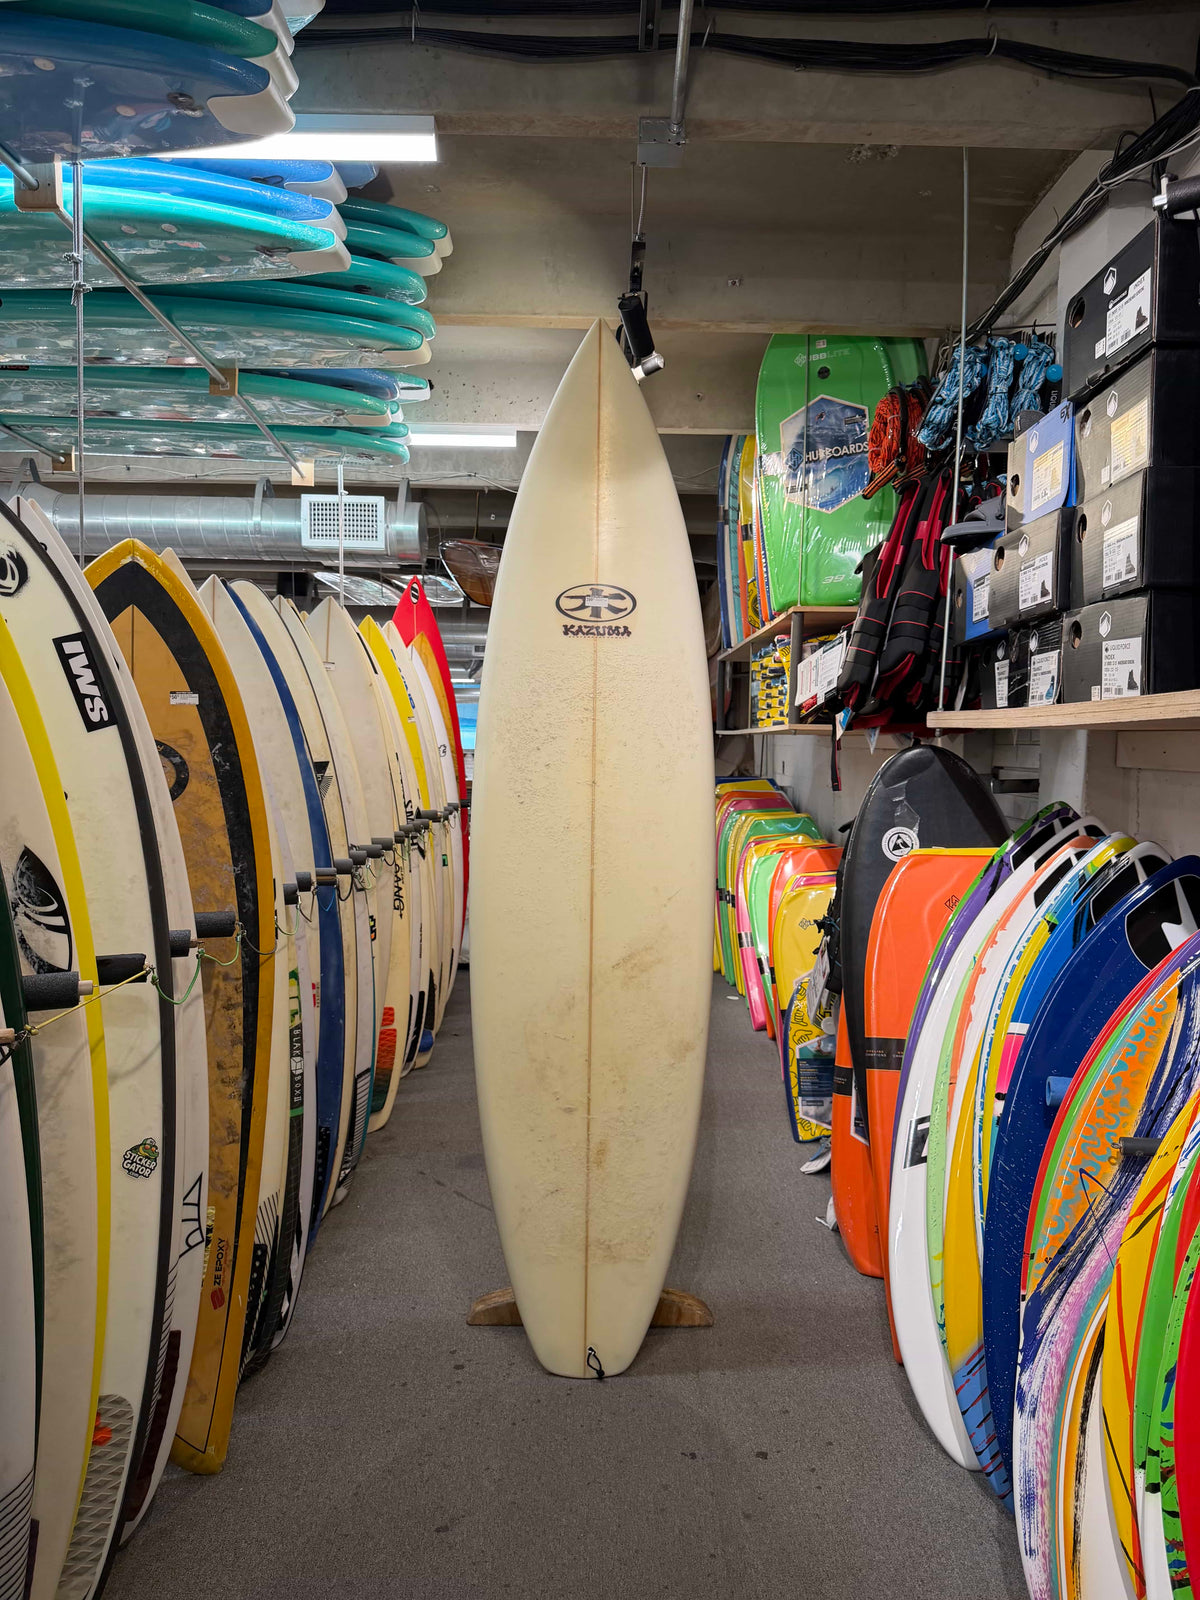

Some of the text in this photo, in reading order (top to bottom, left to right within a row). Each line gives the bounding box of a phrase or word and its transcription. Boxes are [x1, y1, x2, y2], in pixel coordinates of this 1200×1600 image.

[562, 624, 632, 637] KAZUMA
[62, 641, 109, 723] IWS
[292, 1028, 302, 1056] BLAK
[123, 1160, 151, 1177] GATOR
[124, 1151, 156, 1170] STICKER
[215, 1238, 226, 1273] EPOXY
[213, 1274, 222, 1286] ZE
